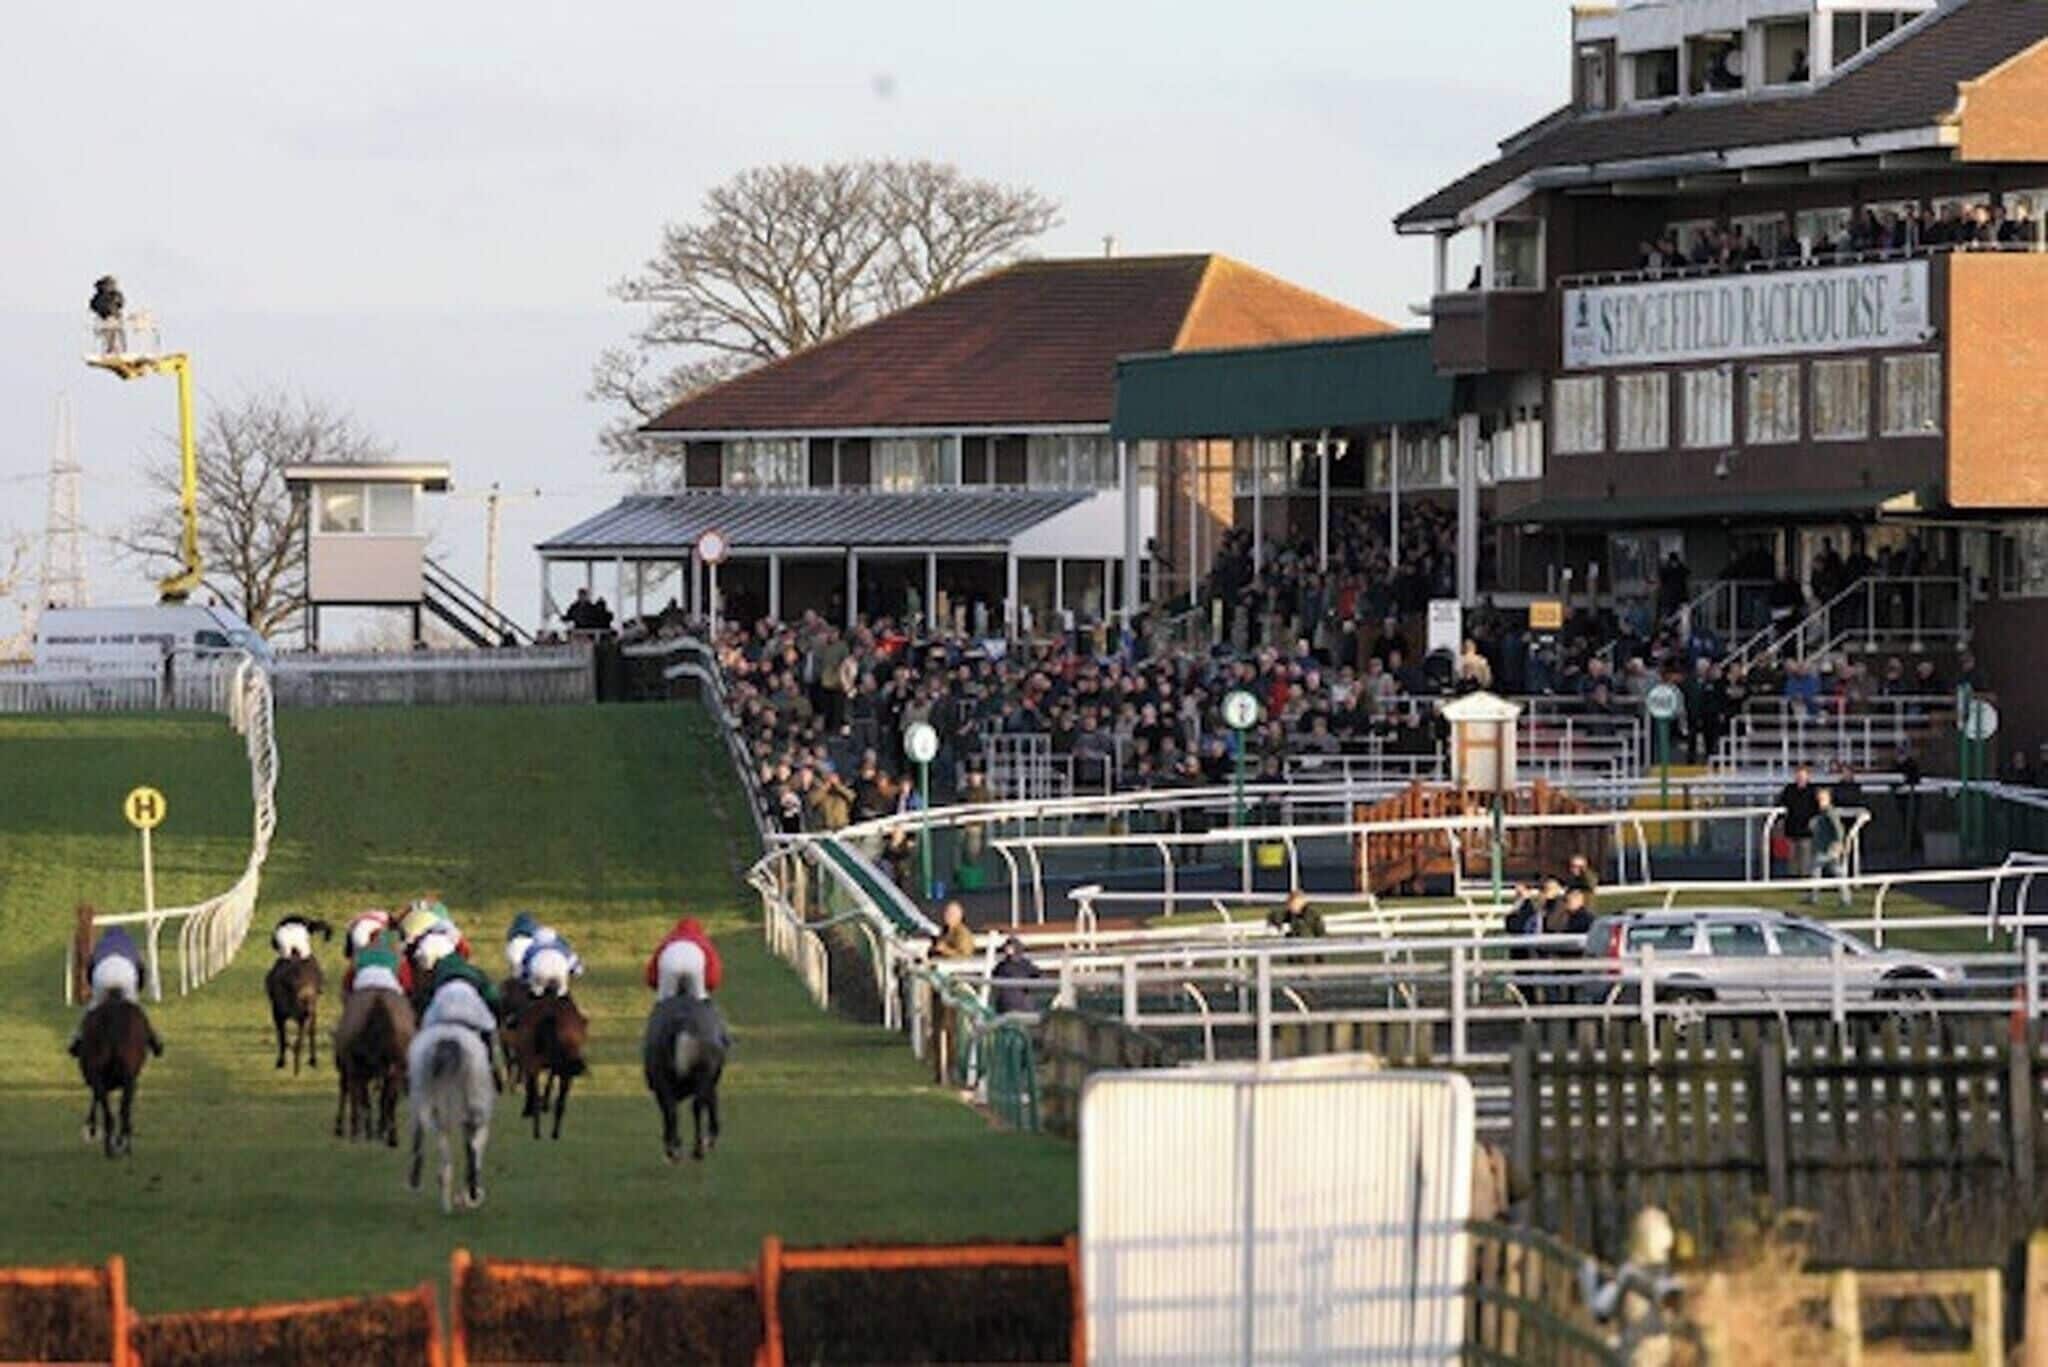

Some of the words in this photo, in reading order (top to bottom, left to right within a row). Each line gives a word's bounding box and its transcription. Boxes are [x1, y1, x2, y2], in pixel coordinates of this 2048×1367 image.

[1600, 286, 1732, 355] SEDGEFIELD
[1742, 274, 1888, 346] RACECOURSE
[134, 796, 156, 820] H
